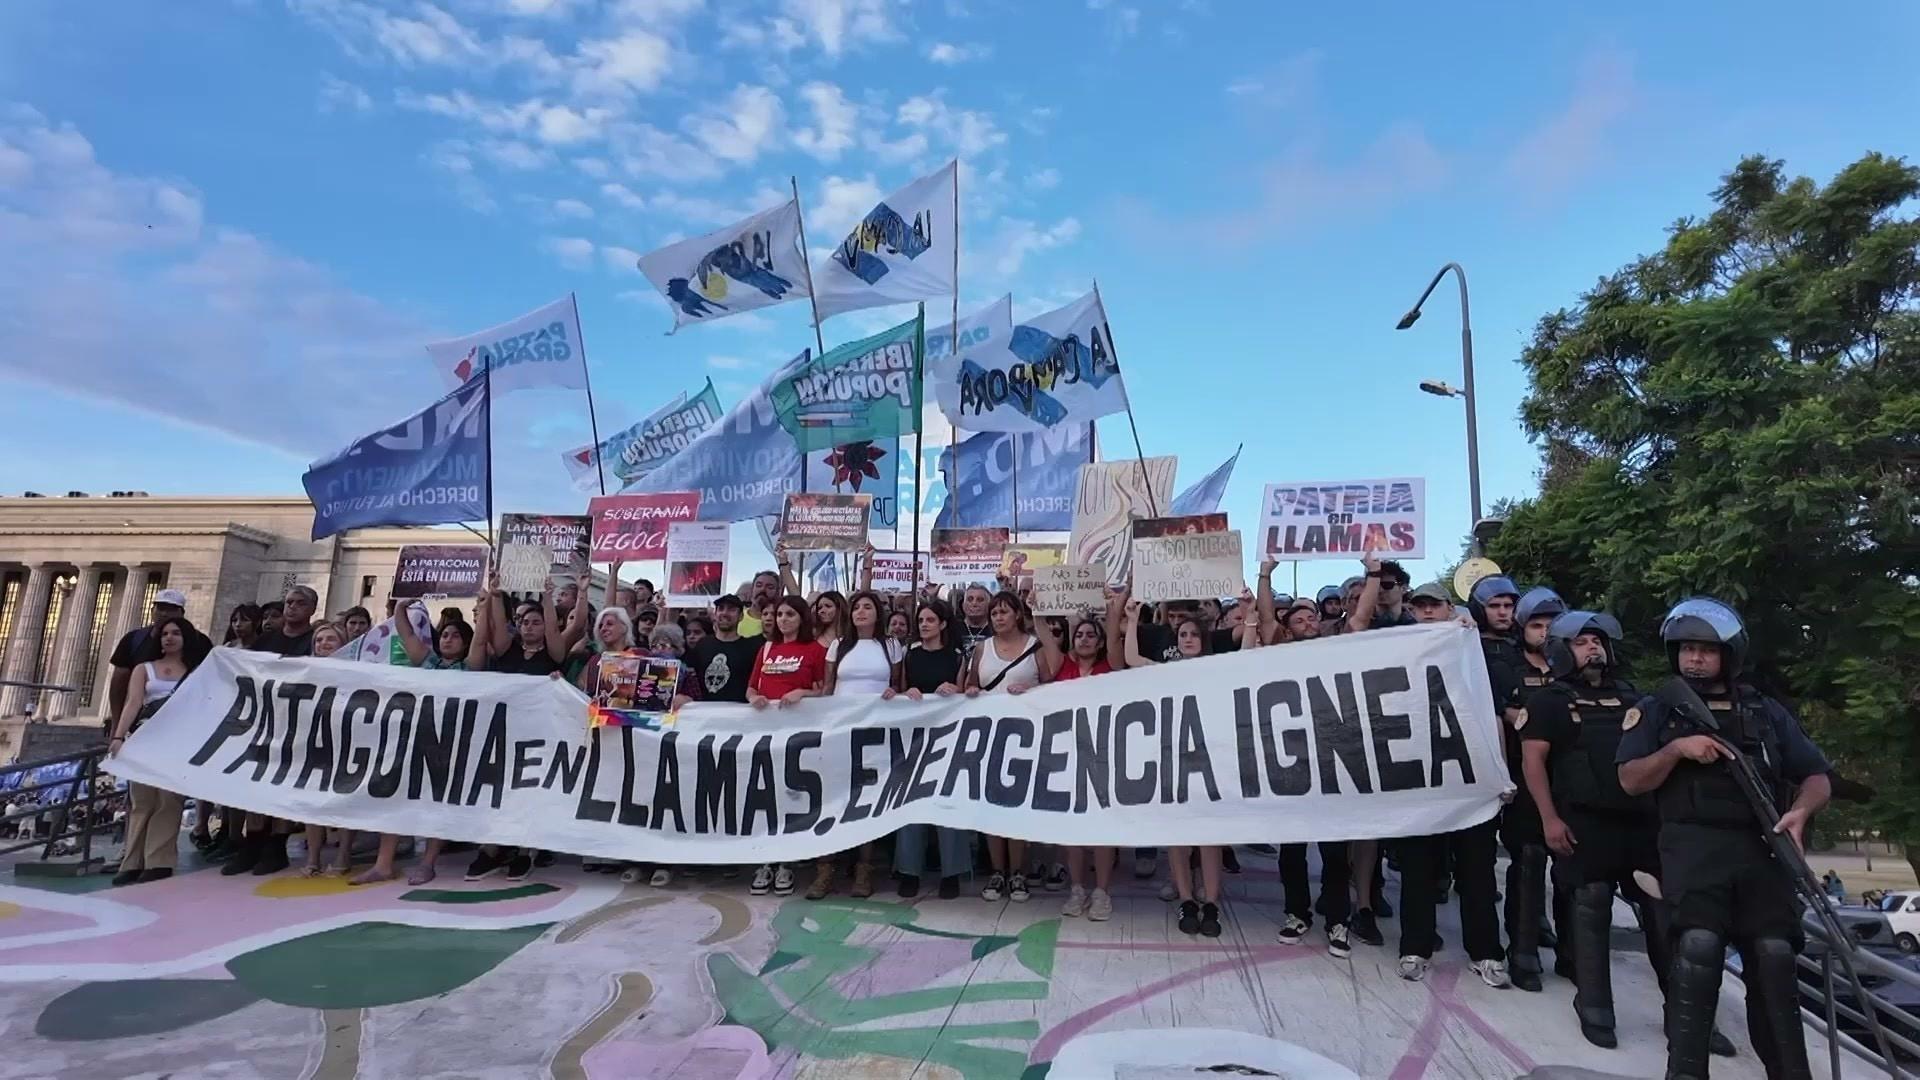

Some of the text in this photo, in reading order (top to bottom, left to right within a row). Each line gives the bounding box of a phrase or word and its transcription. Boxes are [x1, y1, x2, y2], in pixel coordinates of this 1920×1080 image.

[1271, 483, 1416, 516] PATRIA
[1327, 512, 1353, 524] en
[506, 524, 587, 536] LA PATAGONIA
[545, 535, 578, 551] VENDE
[1265, 522, 1416, 554] LLAMAS
[404, 558, 480, 568] LA PATAGONIA
[439, 571, 478, 583] LLAMAS
[896, 571, 924, 582] QUEA
[189, 665, 1476, 837] PATAGONIA EN LLAMAS. EMERGENCIA IGNEA
